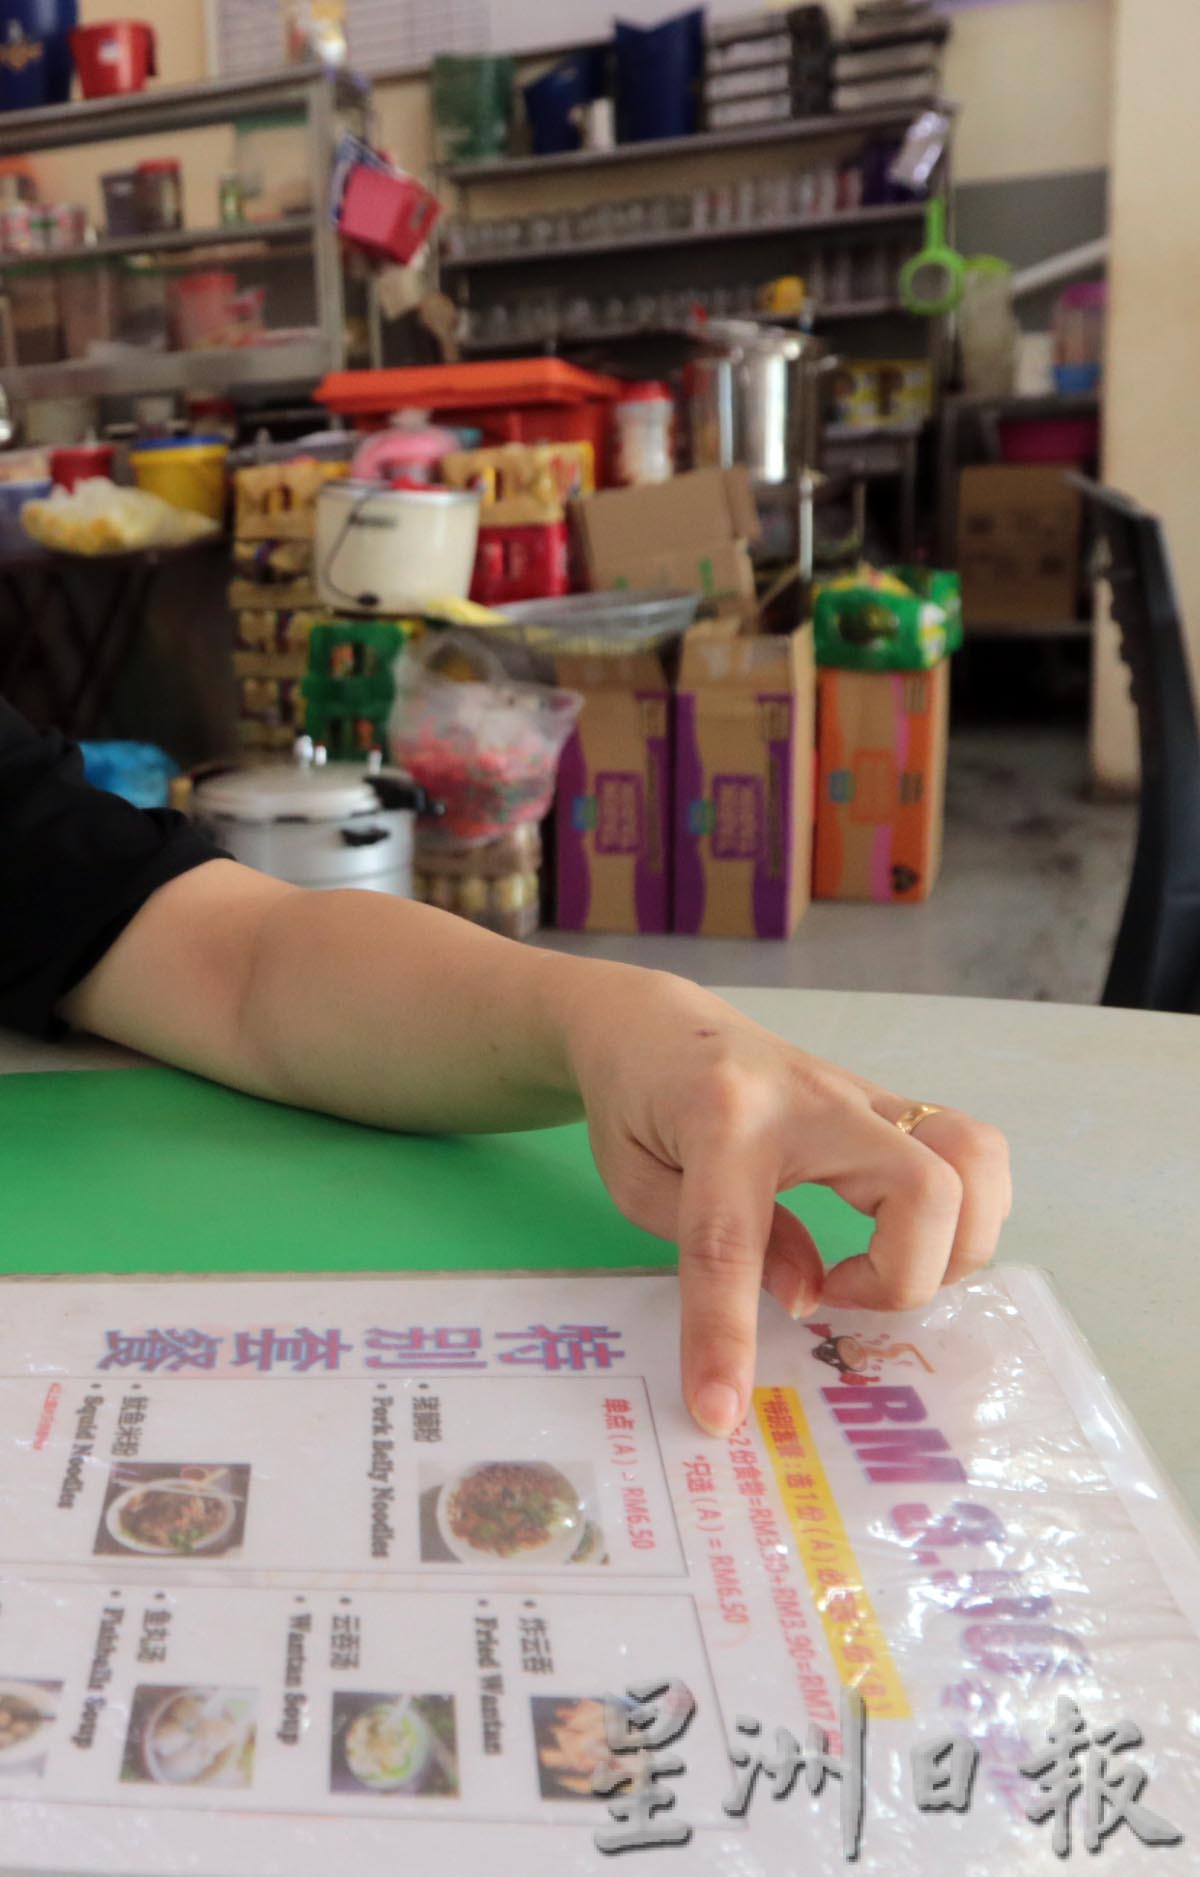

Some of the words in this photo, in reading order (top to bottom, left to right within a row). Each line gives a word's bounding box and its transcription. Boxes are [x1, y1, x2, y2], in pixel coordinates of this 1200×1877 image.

[96, 1321, 627, 1372] 特别套餐
[75, 1395, 105, 1440] Squid
[371, 1395, 394, 1436] Pork
[819, 1386, 968, 1485] RM
[57, 1443, 95, 1510] Noodles
[367, 1439, 394, 1483] Belly
[370, 1486, 394, 1559] Noodles
[620, 1487, 657, 1550] RM6.50
[708, 1554, 750, 1626] RM6.50
[87, 1606, 125, 1692] Fishballs
[285, 1613, 312, 1688] Wantan
[474, 1616, 500, 1669] Fried
[70, 1696, 106, 1750] Soup
[277, 1692, 307, 1747] Soup
[480, 1673, 504, 1756] Wantan
